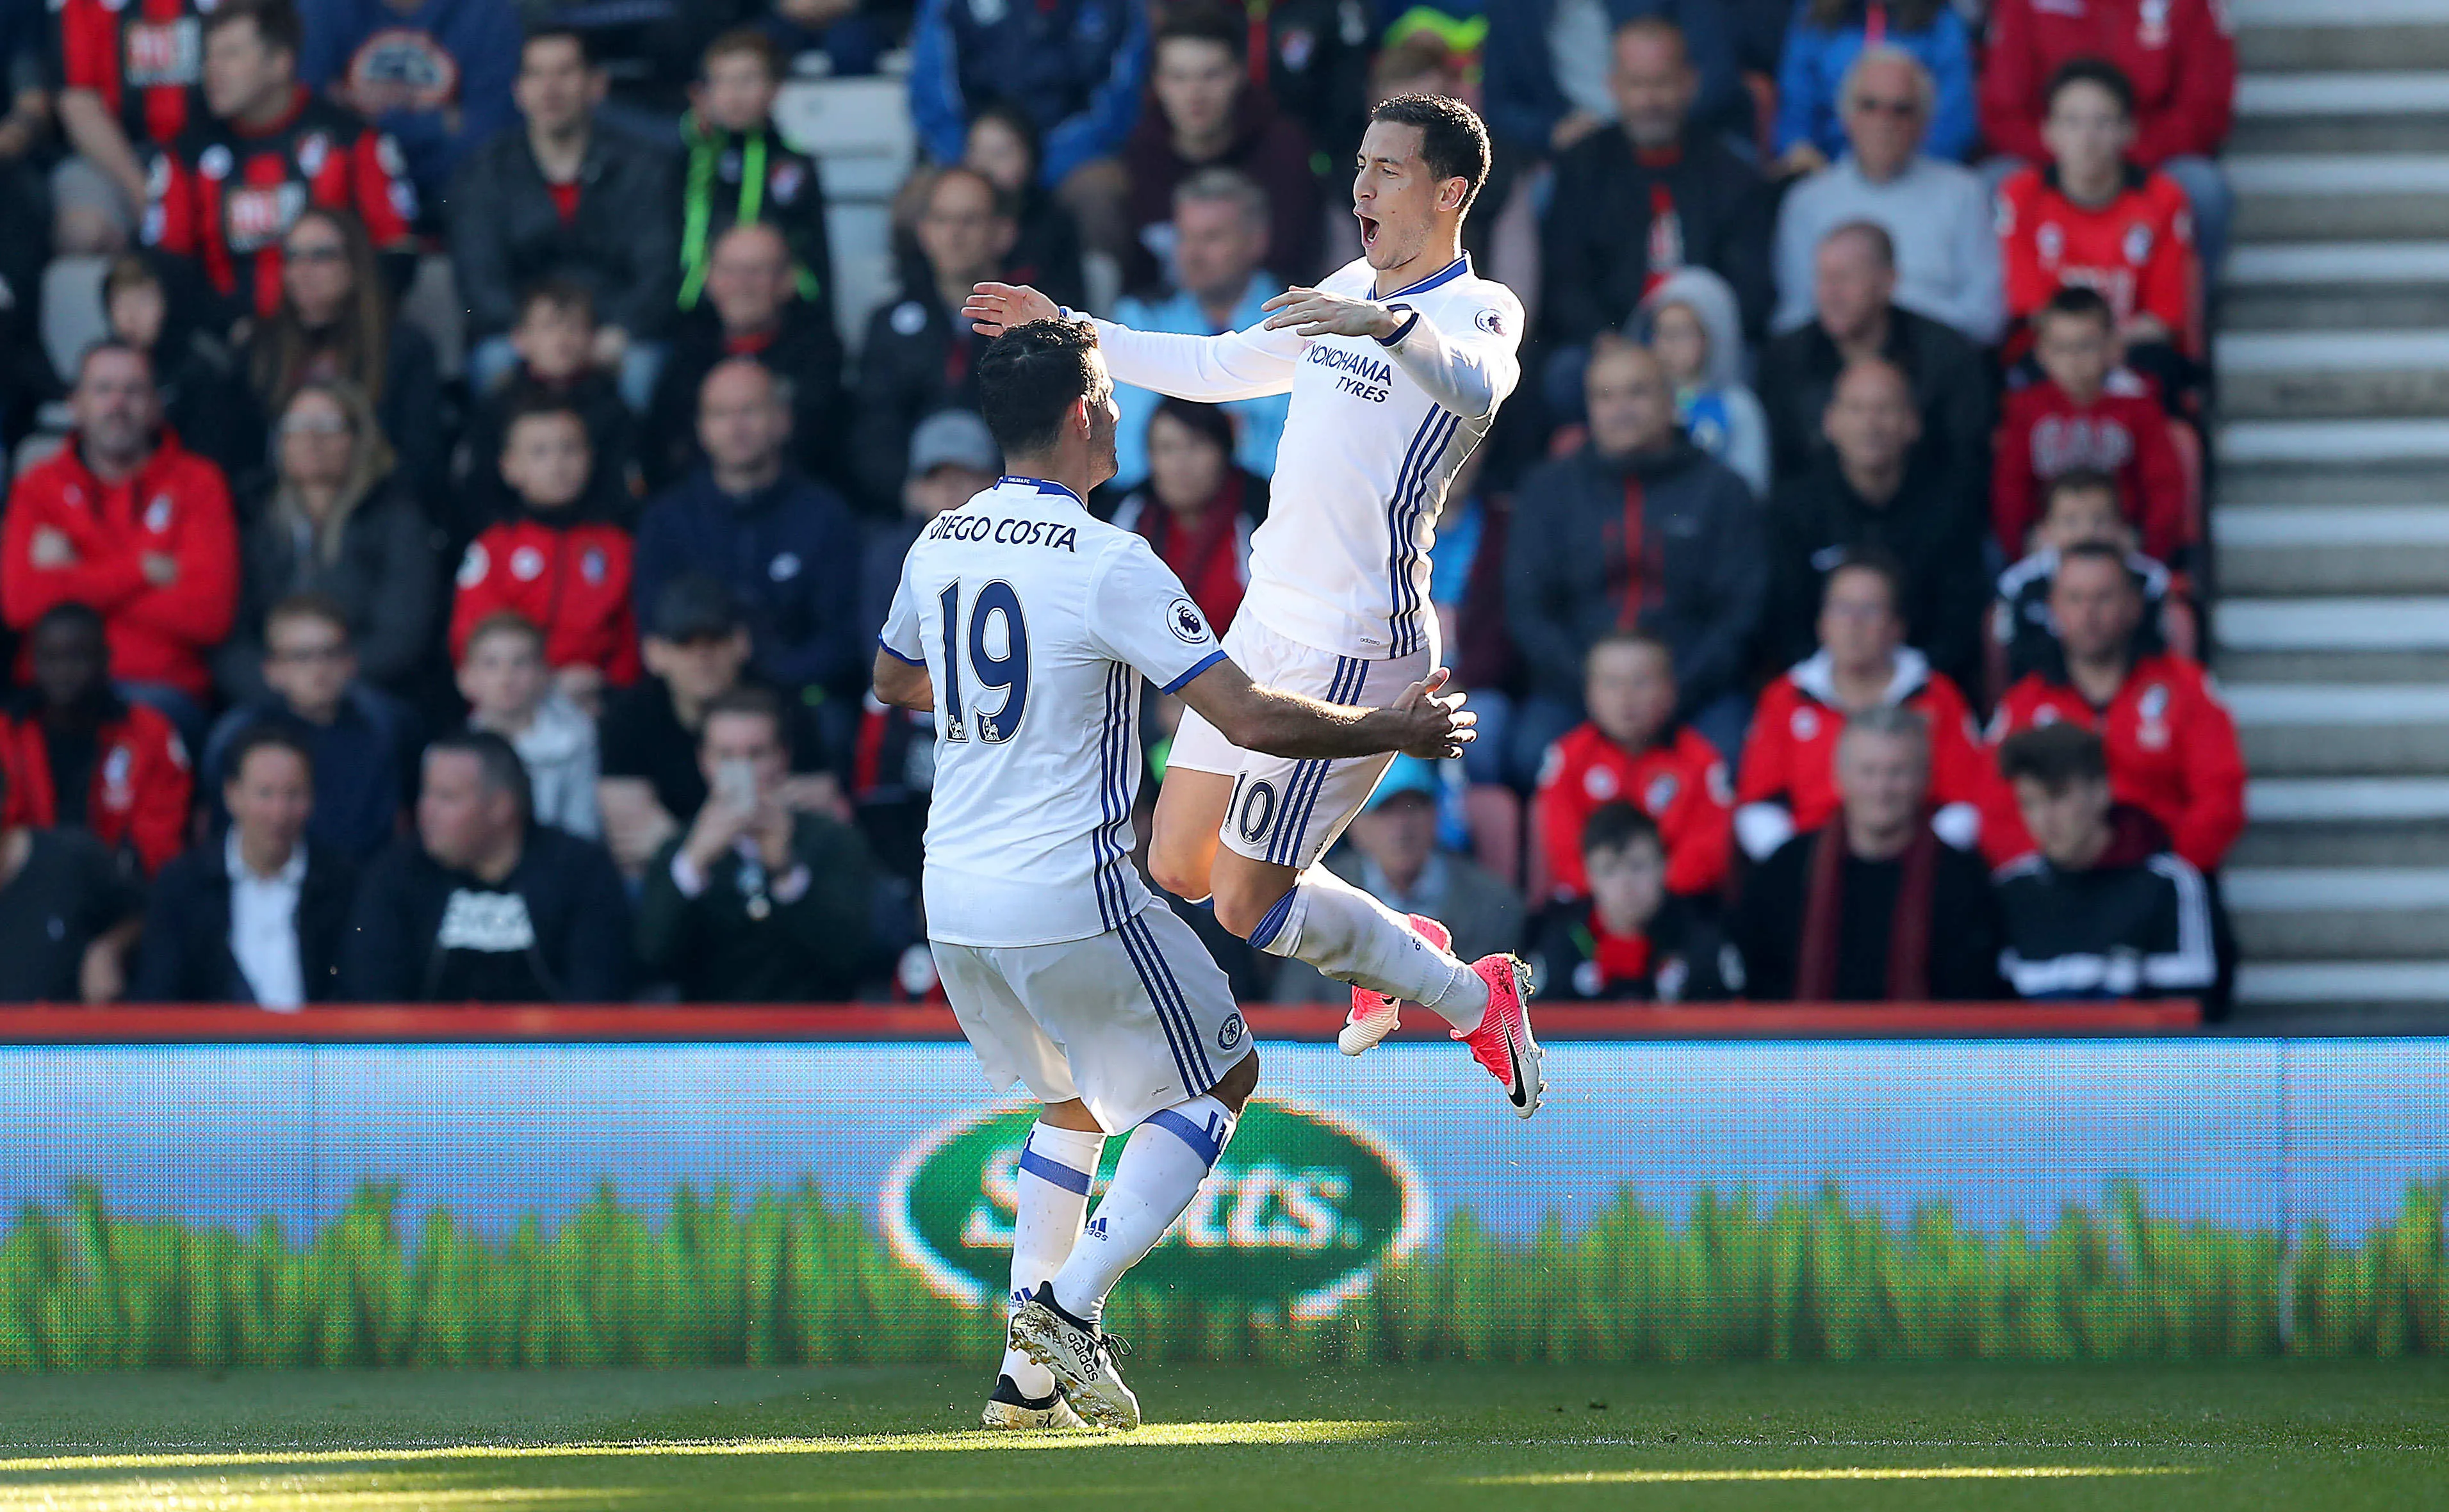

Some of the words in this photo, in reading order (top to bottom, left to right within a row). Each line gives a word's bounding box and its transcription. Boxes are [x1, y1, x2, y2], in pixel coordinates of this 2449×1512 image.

[1307, 343, 1393, 387] YOKOHAMA
[1336, 376, 1390, 403] TYRES
[929, 516, 991, 542] DIEGO
[995, 518, 1077, 553] COSTA
[938, 577, 1031, 744] 19
[1222, 770, 1278, 845] 10
[961, 1151, 1352, 1248] Stts
[1067, 1331, 1099, 1382] adidas
